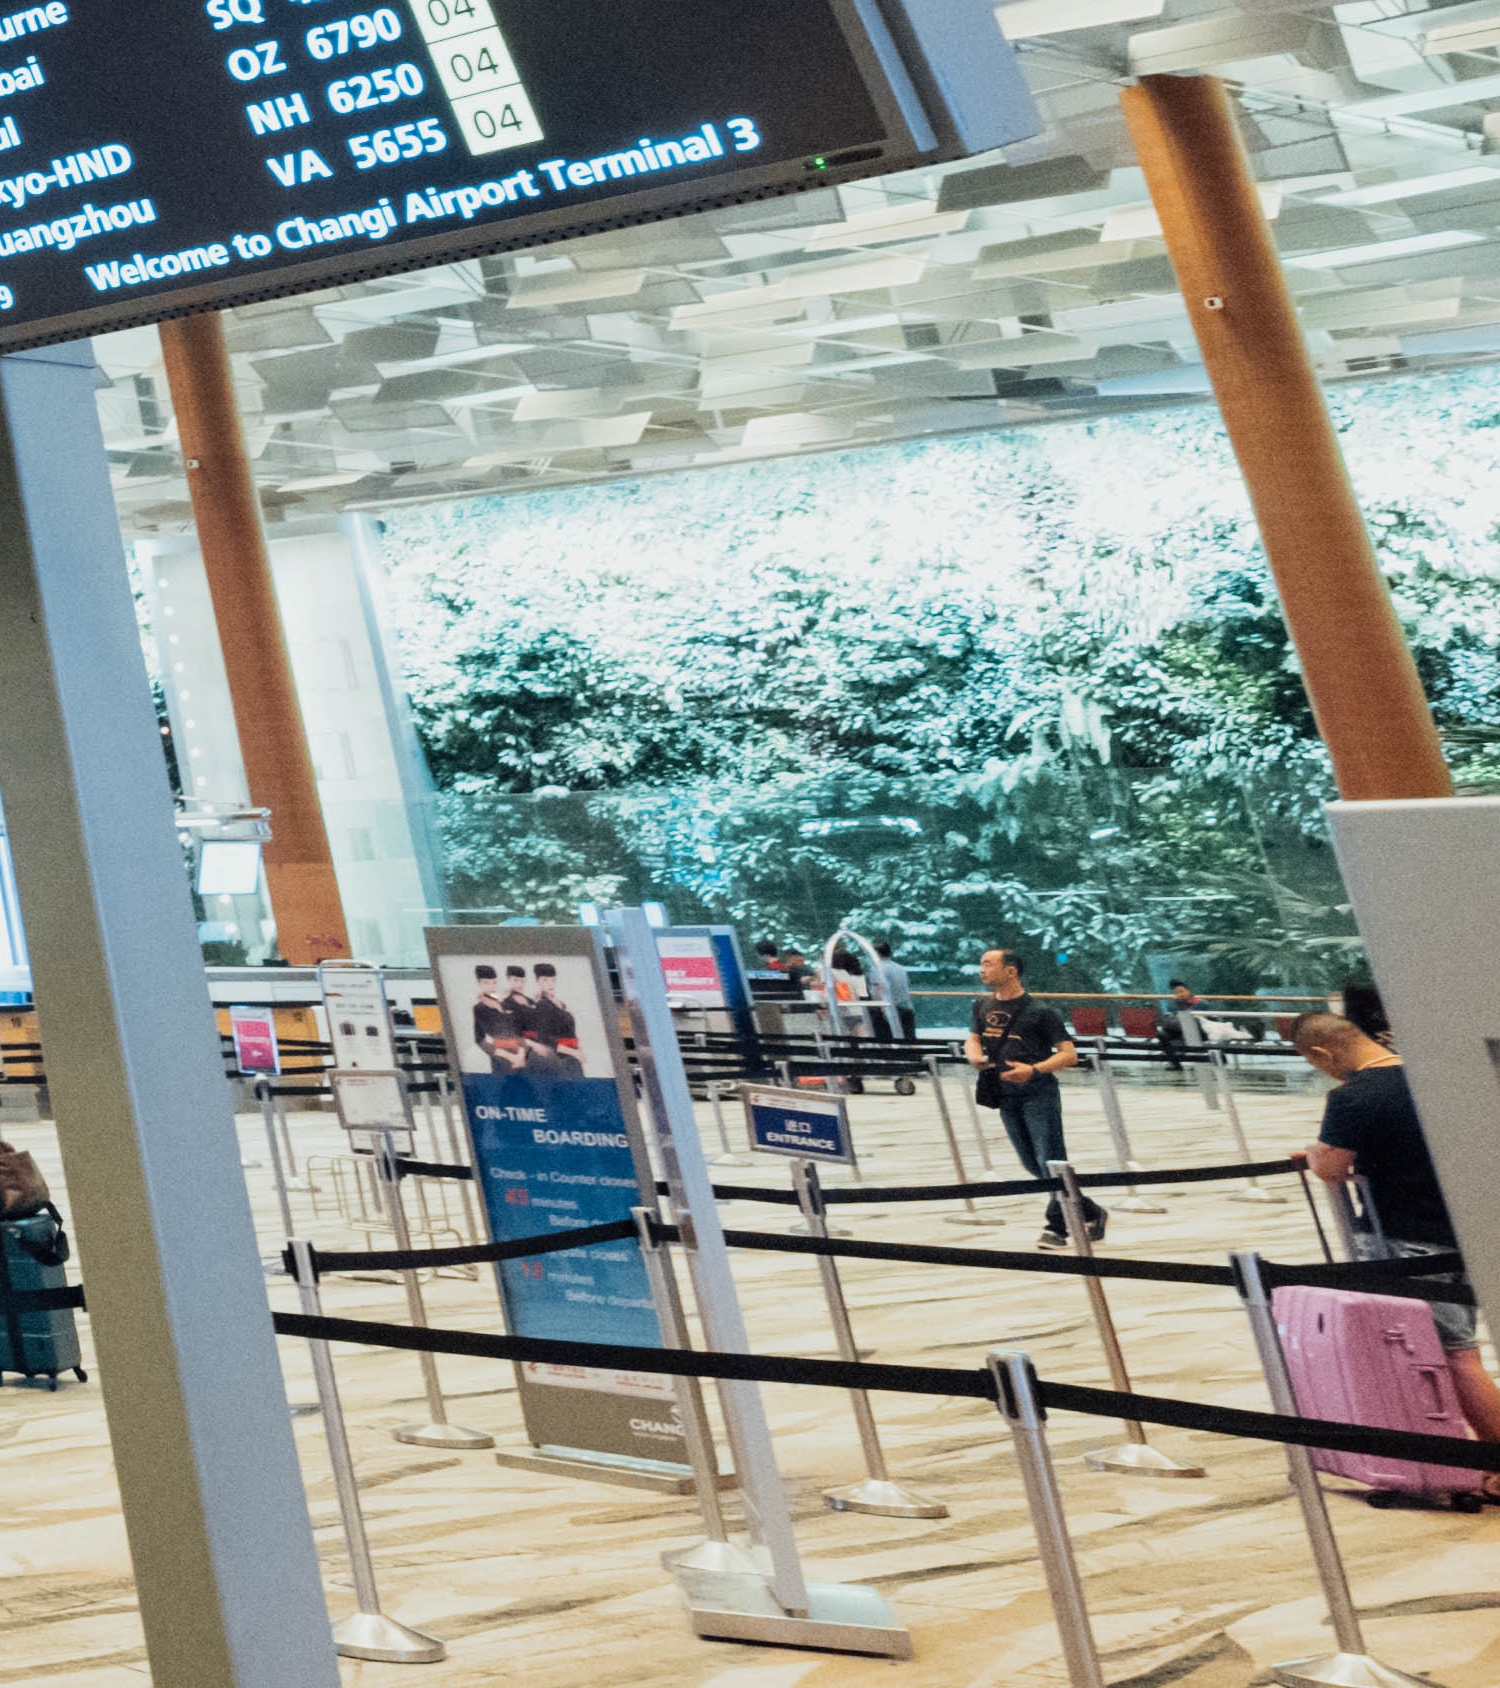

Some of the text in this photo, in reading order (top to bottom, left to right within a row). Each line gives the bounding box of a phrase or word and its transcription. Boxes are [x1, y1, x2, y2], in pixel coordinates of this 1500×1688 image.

[85, 118, 760, 291] Welcome to Changi Airport Terminal 3
[475, 1105, 549, 1124] ON-TIME
[532, 1128, 629, 1148] BOARDING
[765, 1131, 837, 1150] ENTRANCE
